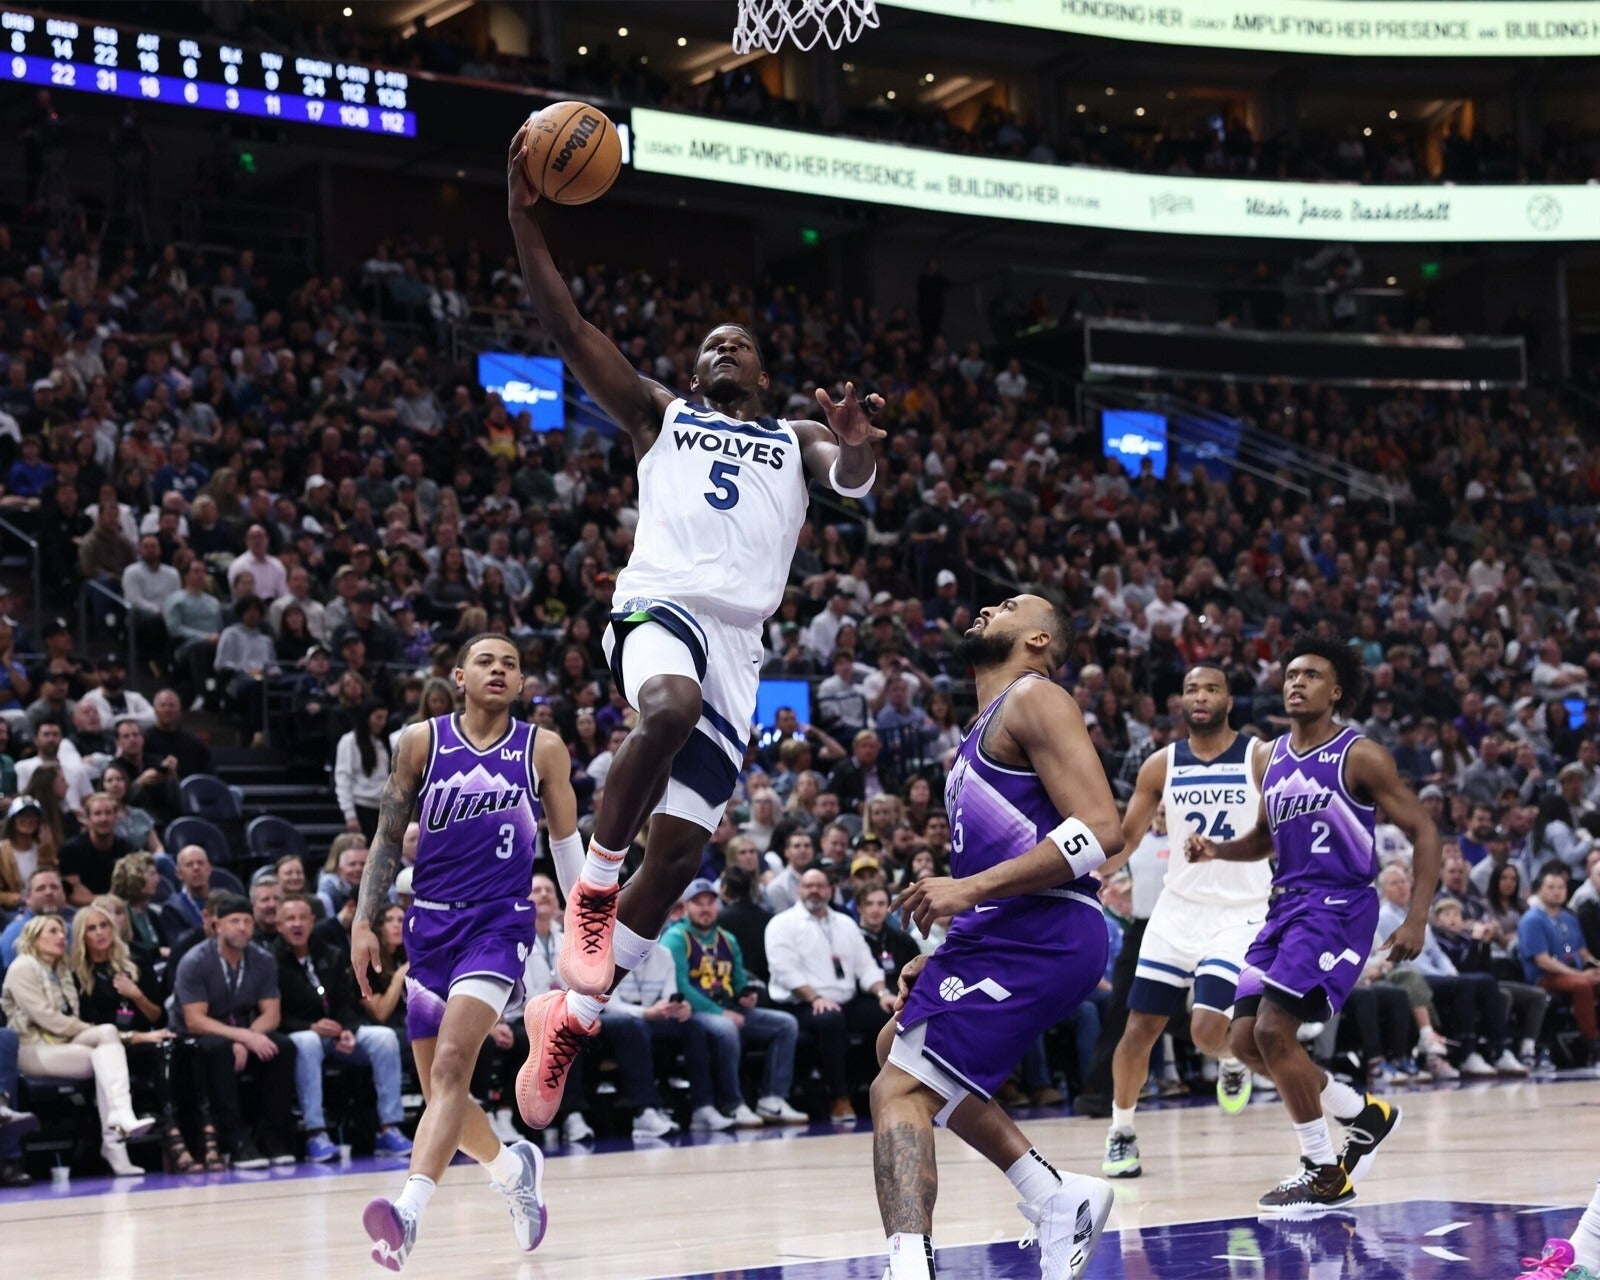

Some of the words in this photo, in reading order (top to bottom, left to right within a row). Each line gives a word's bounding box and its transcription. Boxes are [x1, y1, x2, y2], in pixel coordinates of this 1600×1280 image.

[1062, 0, 1145, 23] HONORING
[1149, 8, 1183, 28] HER
[1232, 14, 1333, 36] AMPLIFYING
[1336, 19, 1372, 38] HER
[1375, 20, 1471, 40] PRESENCE
[1505, 20, 1588, 40] BUILDING
[51, 37, 74, 60] 14
[93, 44, 118, 67] 22
[302, 76, 327, 97] 24
[11, 56, 27, 79] 9
[51, 62, 76, 86] 22
[96, 69, 118, 92] 31
[225, 88, 240, 110] 3
[264, 94, 281, 116] 11
[305, 101, 325, 122] 17
[551, 114, 600, 173] Wilson
[688, 139, 792, 171] AMPLIFYING
[795, 158, 828, 177] HER
[832, 162, 916, 190] PRESENCE
[948, 176, 1023, 201] BUILDING
[1027, 187, 1061, 207] HER
[1245, 197, 1289, 216] Utah
[1350, 199, 1450, 222] Basketball
[673, 429, 785, 470] WOLVES
[704, 460, 740, 511] 5
[501, 747, 523, 762] LVT
[1318, 752, 1341, 764] LVT
[426, 786, 527, 834] UTAH
[1173, 789, 1246, 806] WOLVES
[1266, 790, 1336, 836] UTAH
[495, 823, 515, 859] 3
[1063, 833, 1089, 856] 5
[1184, 810, 1236, 841] 24
[1310, 821, 1331, 854] 2
